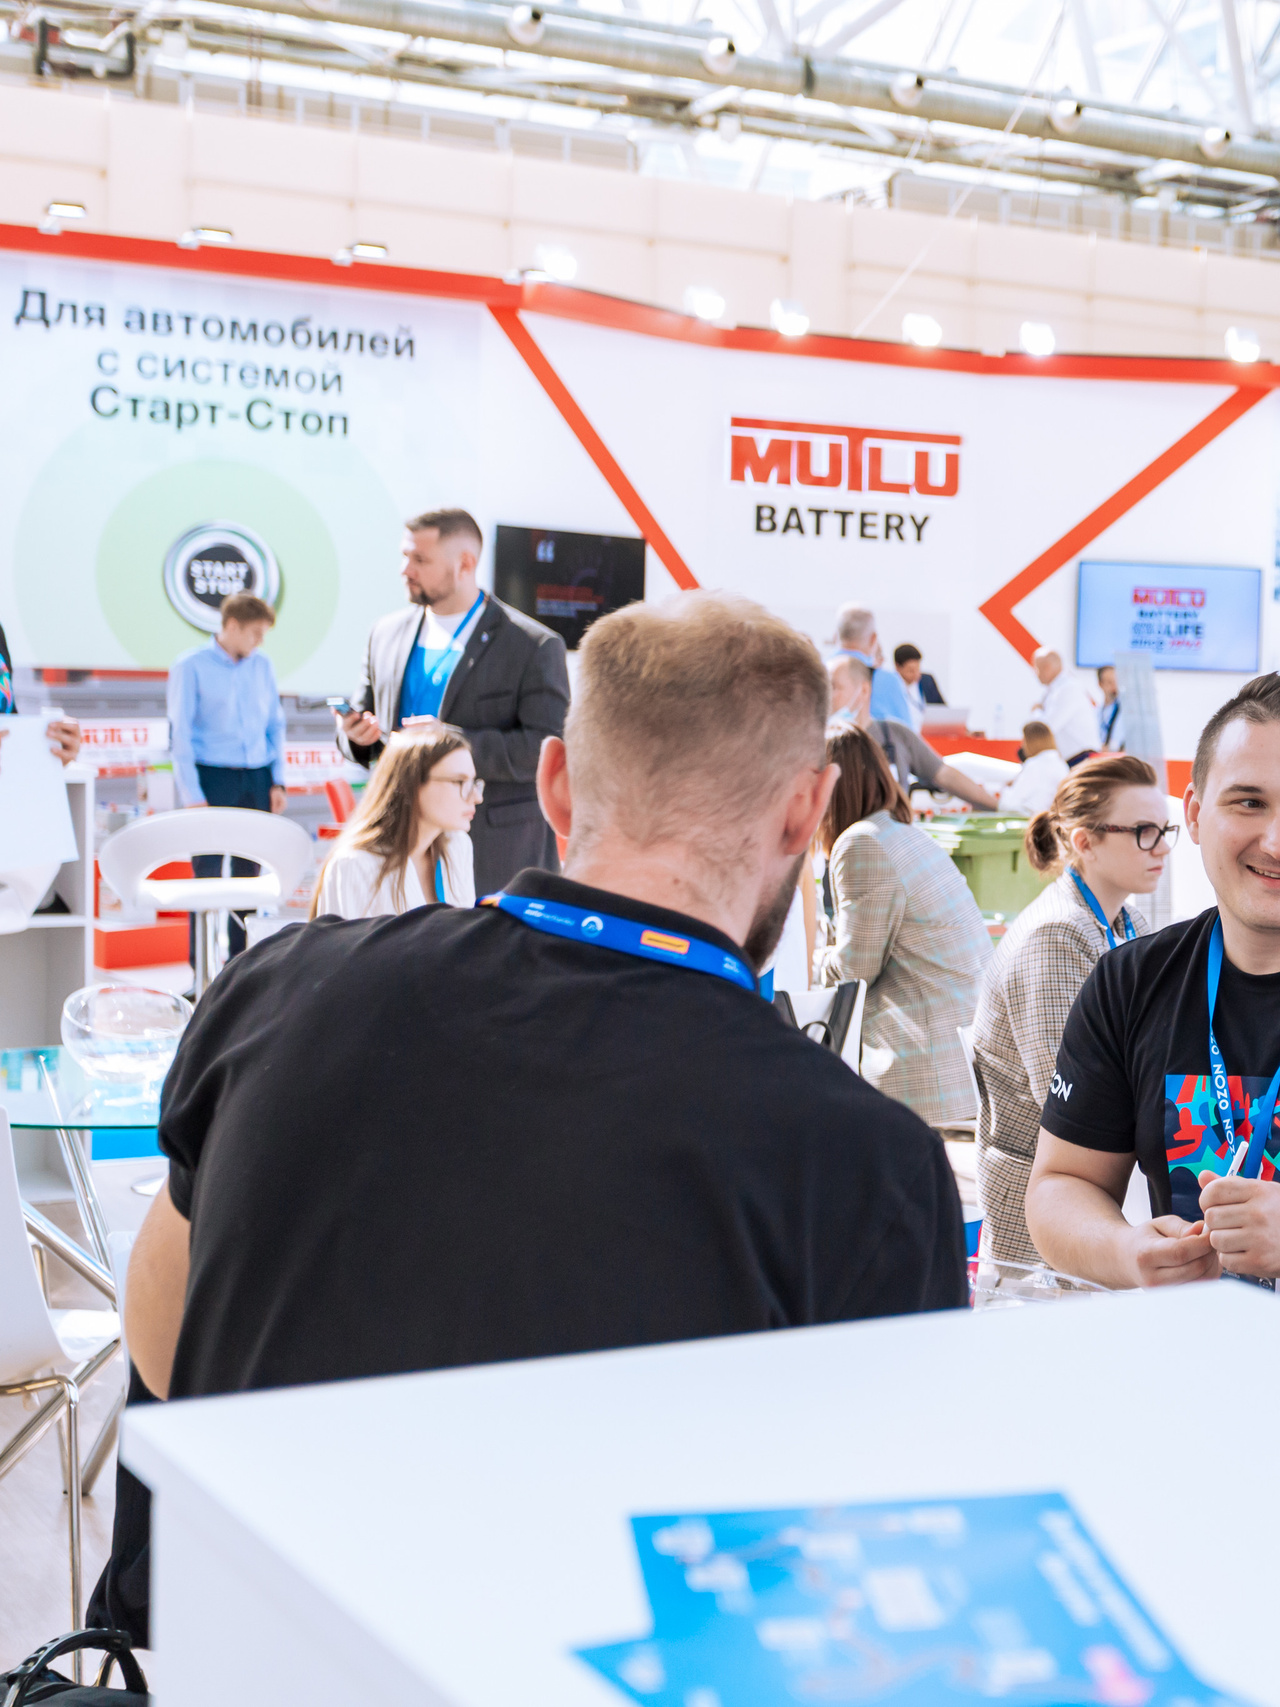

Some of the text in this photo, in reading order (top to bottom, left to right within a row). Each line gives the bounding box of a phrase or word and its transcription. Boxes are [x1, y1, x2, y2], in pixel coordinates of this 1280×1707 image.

[16, 288, 416, 360] Для автомобилей
[97, 350, 343, 394] с системой
[90, 384, 349, 437] Старт-Стоп
[731, 416, 961, 497] MUTLU
[755, 504, 930, 543] BATTERY
[190, 559, 248, 579] START
[1213, 1063, 1229, 1110] OZON
